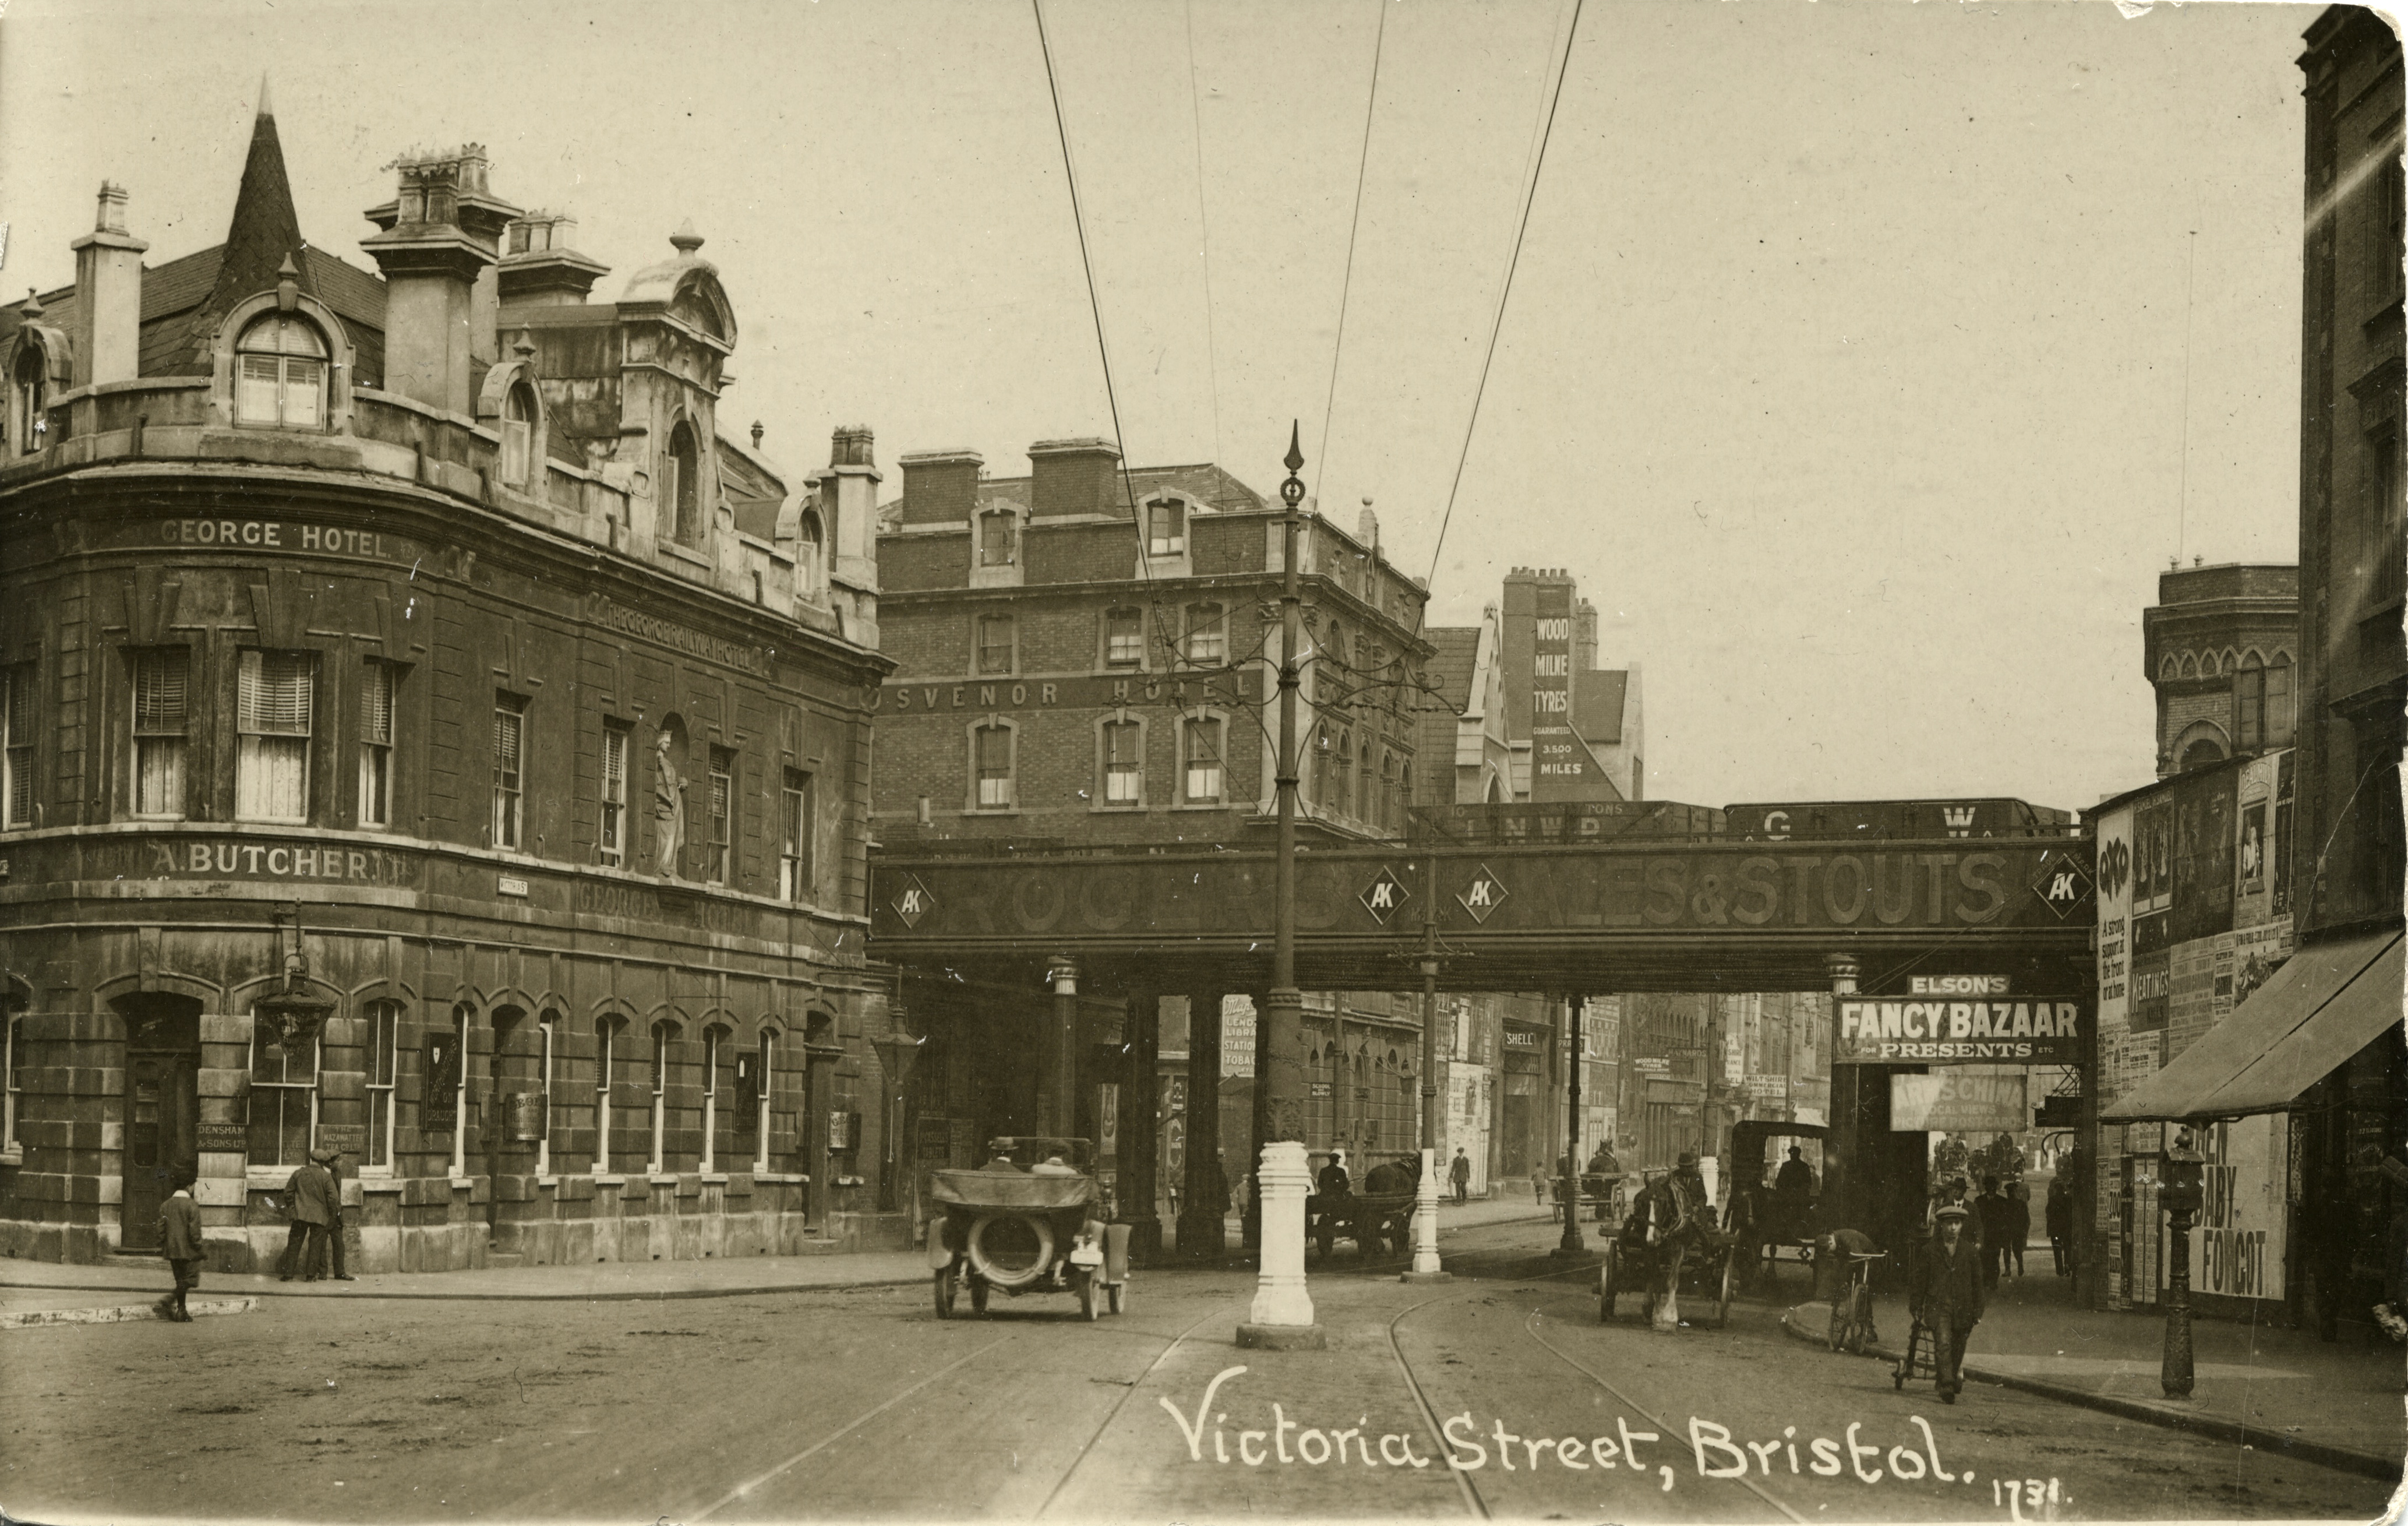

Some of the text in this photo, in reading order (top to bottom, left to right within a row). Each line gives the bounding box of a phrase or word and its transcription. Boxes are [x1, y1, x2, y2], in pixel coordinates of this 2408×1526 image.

[161, 520, 281, 546] GEORGE
[1537, 619, 1569, 640] WOOD
[1535, 654, 1568, 676] MILNE
[1533, 691, 1567, 713] TYRES
[1533, 727, 1571, 735] GUARANTEED
[1541, 763, 1582, 774] MILES
[1585, 802, 1622, 815] TONS
[1764, 806, 1976, 841] G W
[2099, 836, 2129, 904] OXO
[1370, 883, 1393, 908] AK
[1468, 880, 1492, 906] AK
[2048, 873, 2076, 900] AK
[901, 890, 921, 914] AK
[2102, 915, 2125, 938] A strong
[2102, 940, 2120, 960] support
[2119, 938, 2124, 954] at
[2112, 959, 2124, 978] front
[2103, 979, 2124, 1001] or at home
[1841, 1003, 2078, 1038] FANCY BAZAAR
[1226, 1028, 1256, 1037] LIBRA
[1226, 1055, 1255, 1065] TOBAC
[1879, 1042, 2032, 1058] PRESENTS
[1652, 1058, 1670, 1066] MILNE
[1958, 1077, 2023, 1109] CHINA
[428, 1109, 457, 1122] DRAUGHT
[1961, 1104, 1996, 1114] VIEWS
[198, 1126, 245, 1134] DENSHAM
